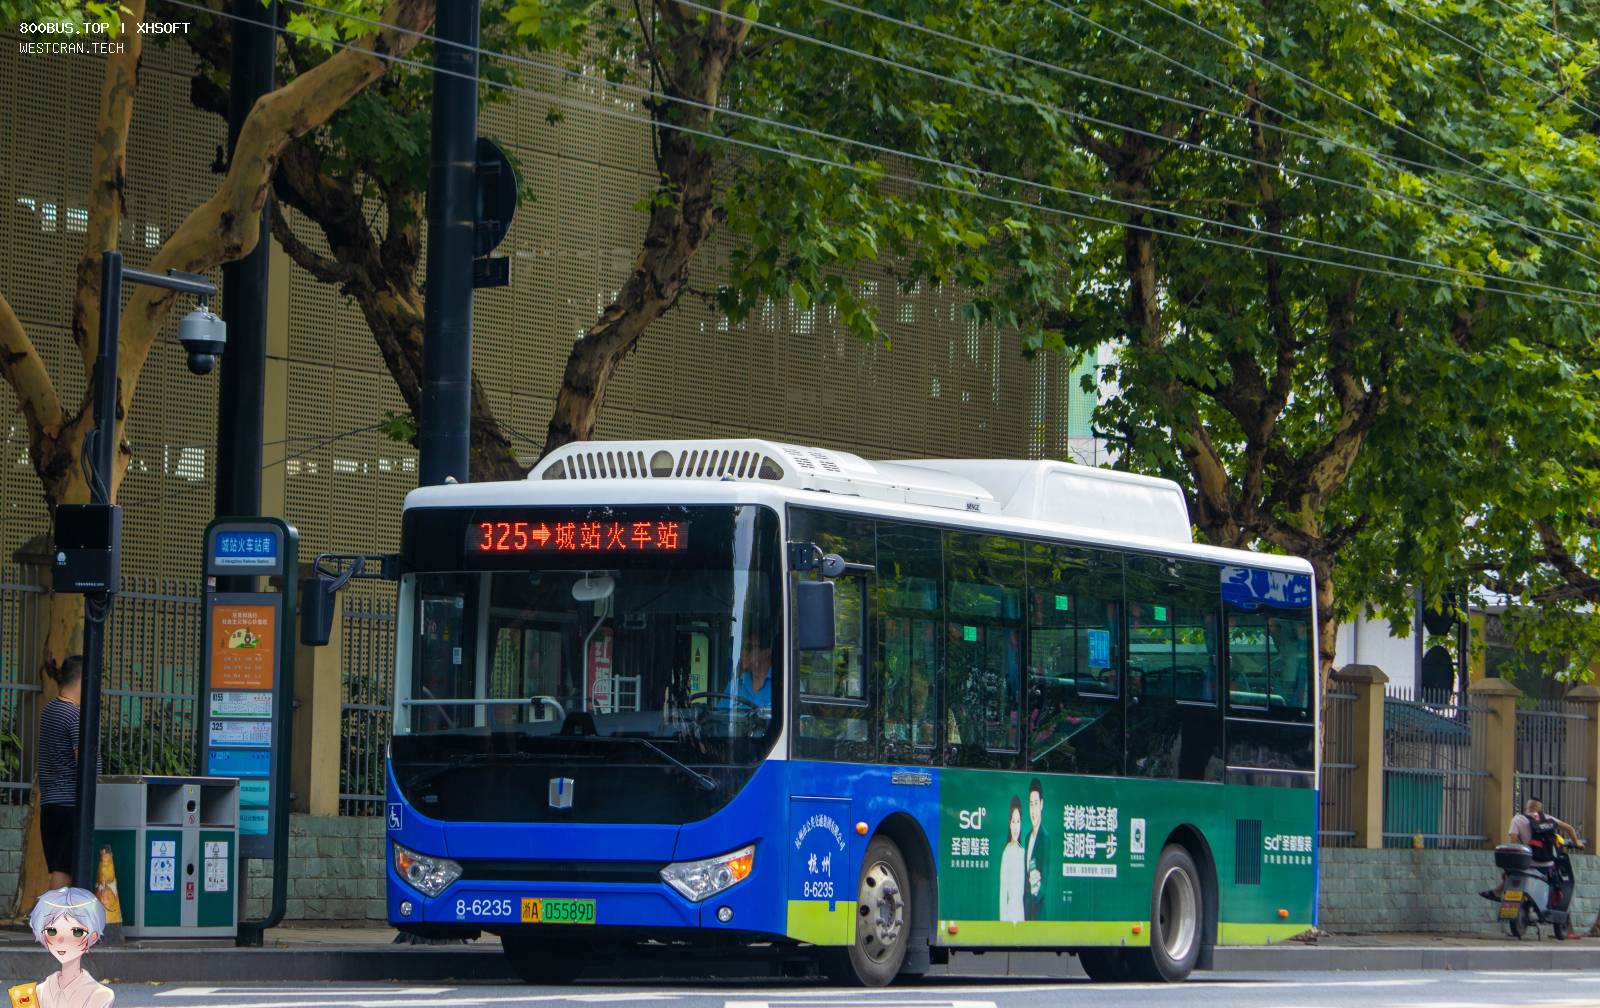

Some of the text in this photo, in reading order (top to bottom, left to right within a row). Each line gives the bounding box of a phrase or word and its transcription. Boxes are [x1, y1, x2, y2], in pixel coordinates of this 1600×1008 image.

[221, 537, 271, 553] 城站火车站南
[480, 522, 679, 550] 325 城站火车站
[211, 722, 224, 731] 325
[1063, 804, 1118, 832] 装修选圣都
[951, 837, 990, 856] 圣都整装
[1063, 832, 1118, 859] 透明每一步
[808, 851, 832, 878] 杭州
[803, 881, 834, 898] 8-6235
[456, 899, 512, 916] 8-6235
[522, 902, 594, 921] 浙A 05589D
